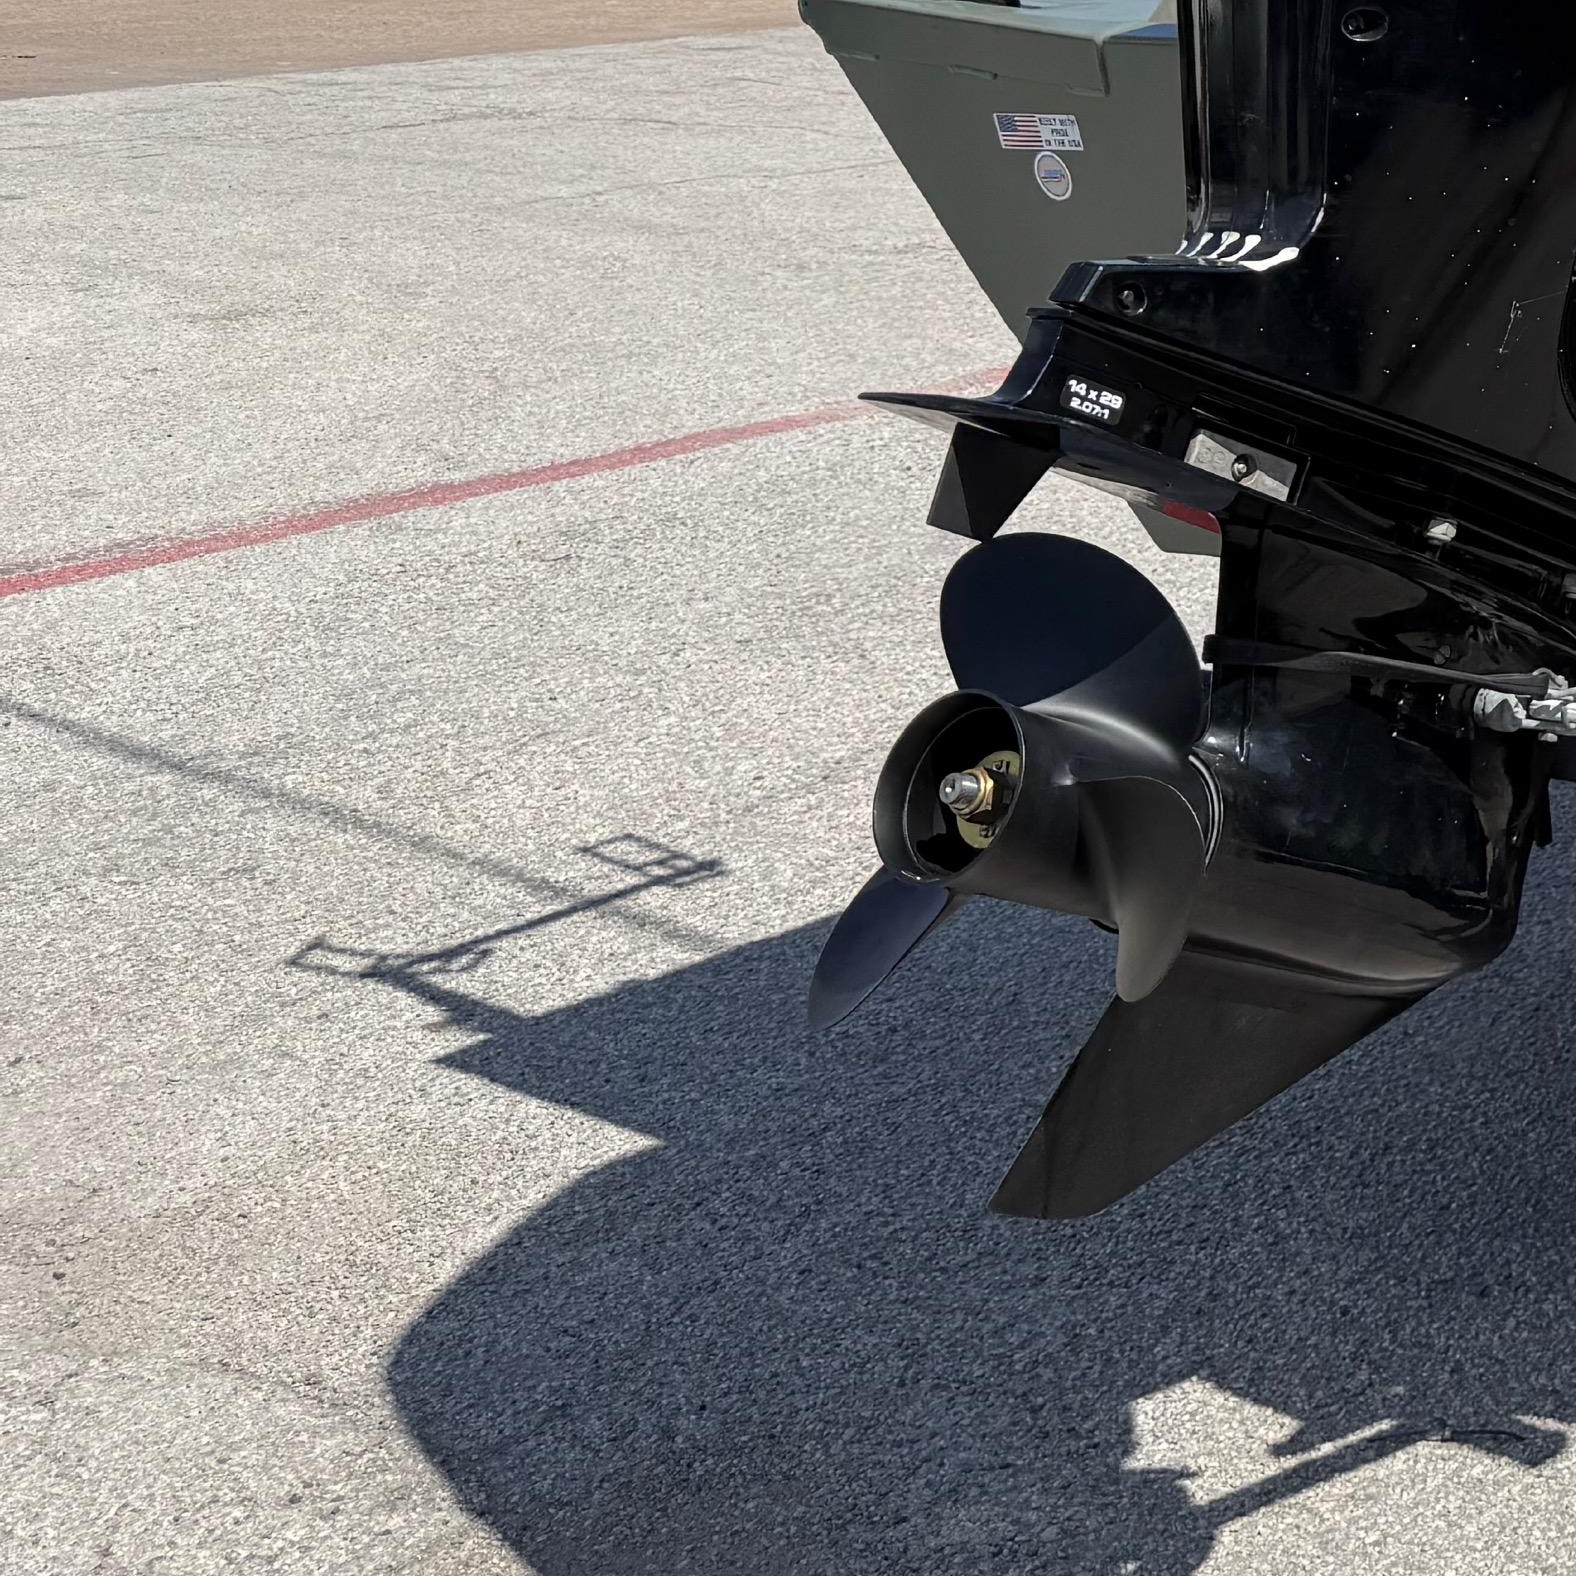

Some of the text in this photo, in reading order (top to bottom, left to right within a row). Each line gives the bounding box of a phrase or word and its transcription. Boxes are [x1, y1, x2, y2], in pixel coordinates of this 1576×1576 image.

[1068, 379, 1123, 409] 14 x 29
[1070, 396, 1110, 420] 2.07:1
